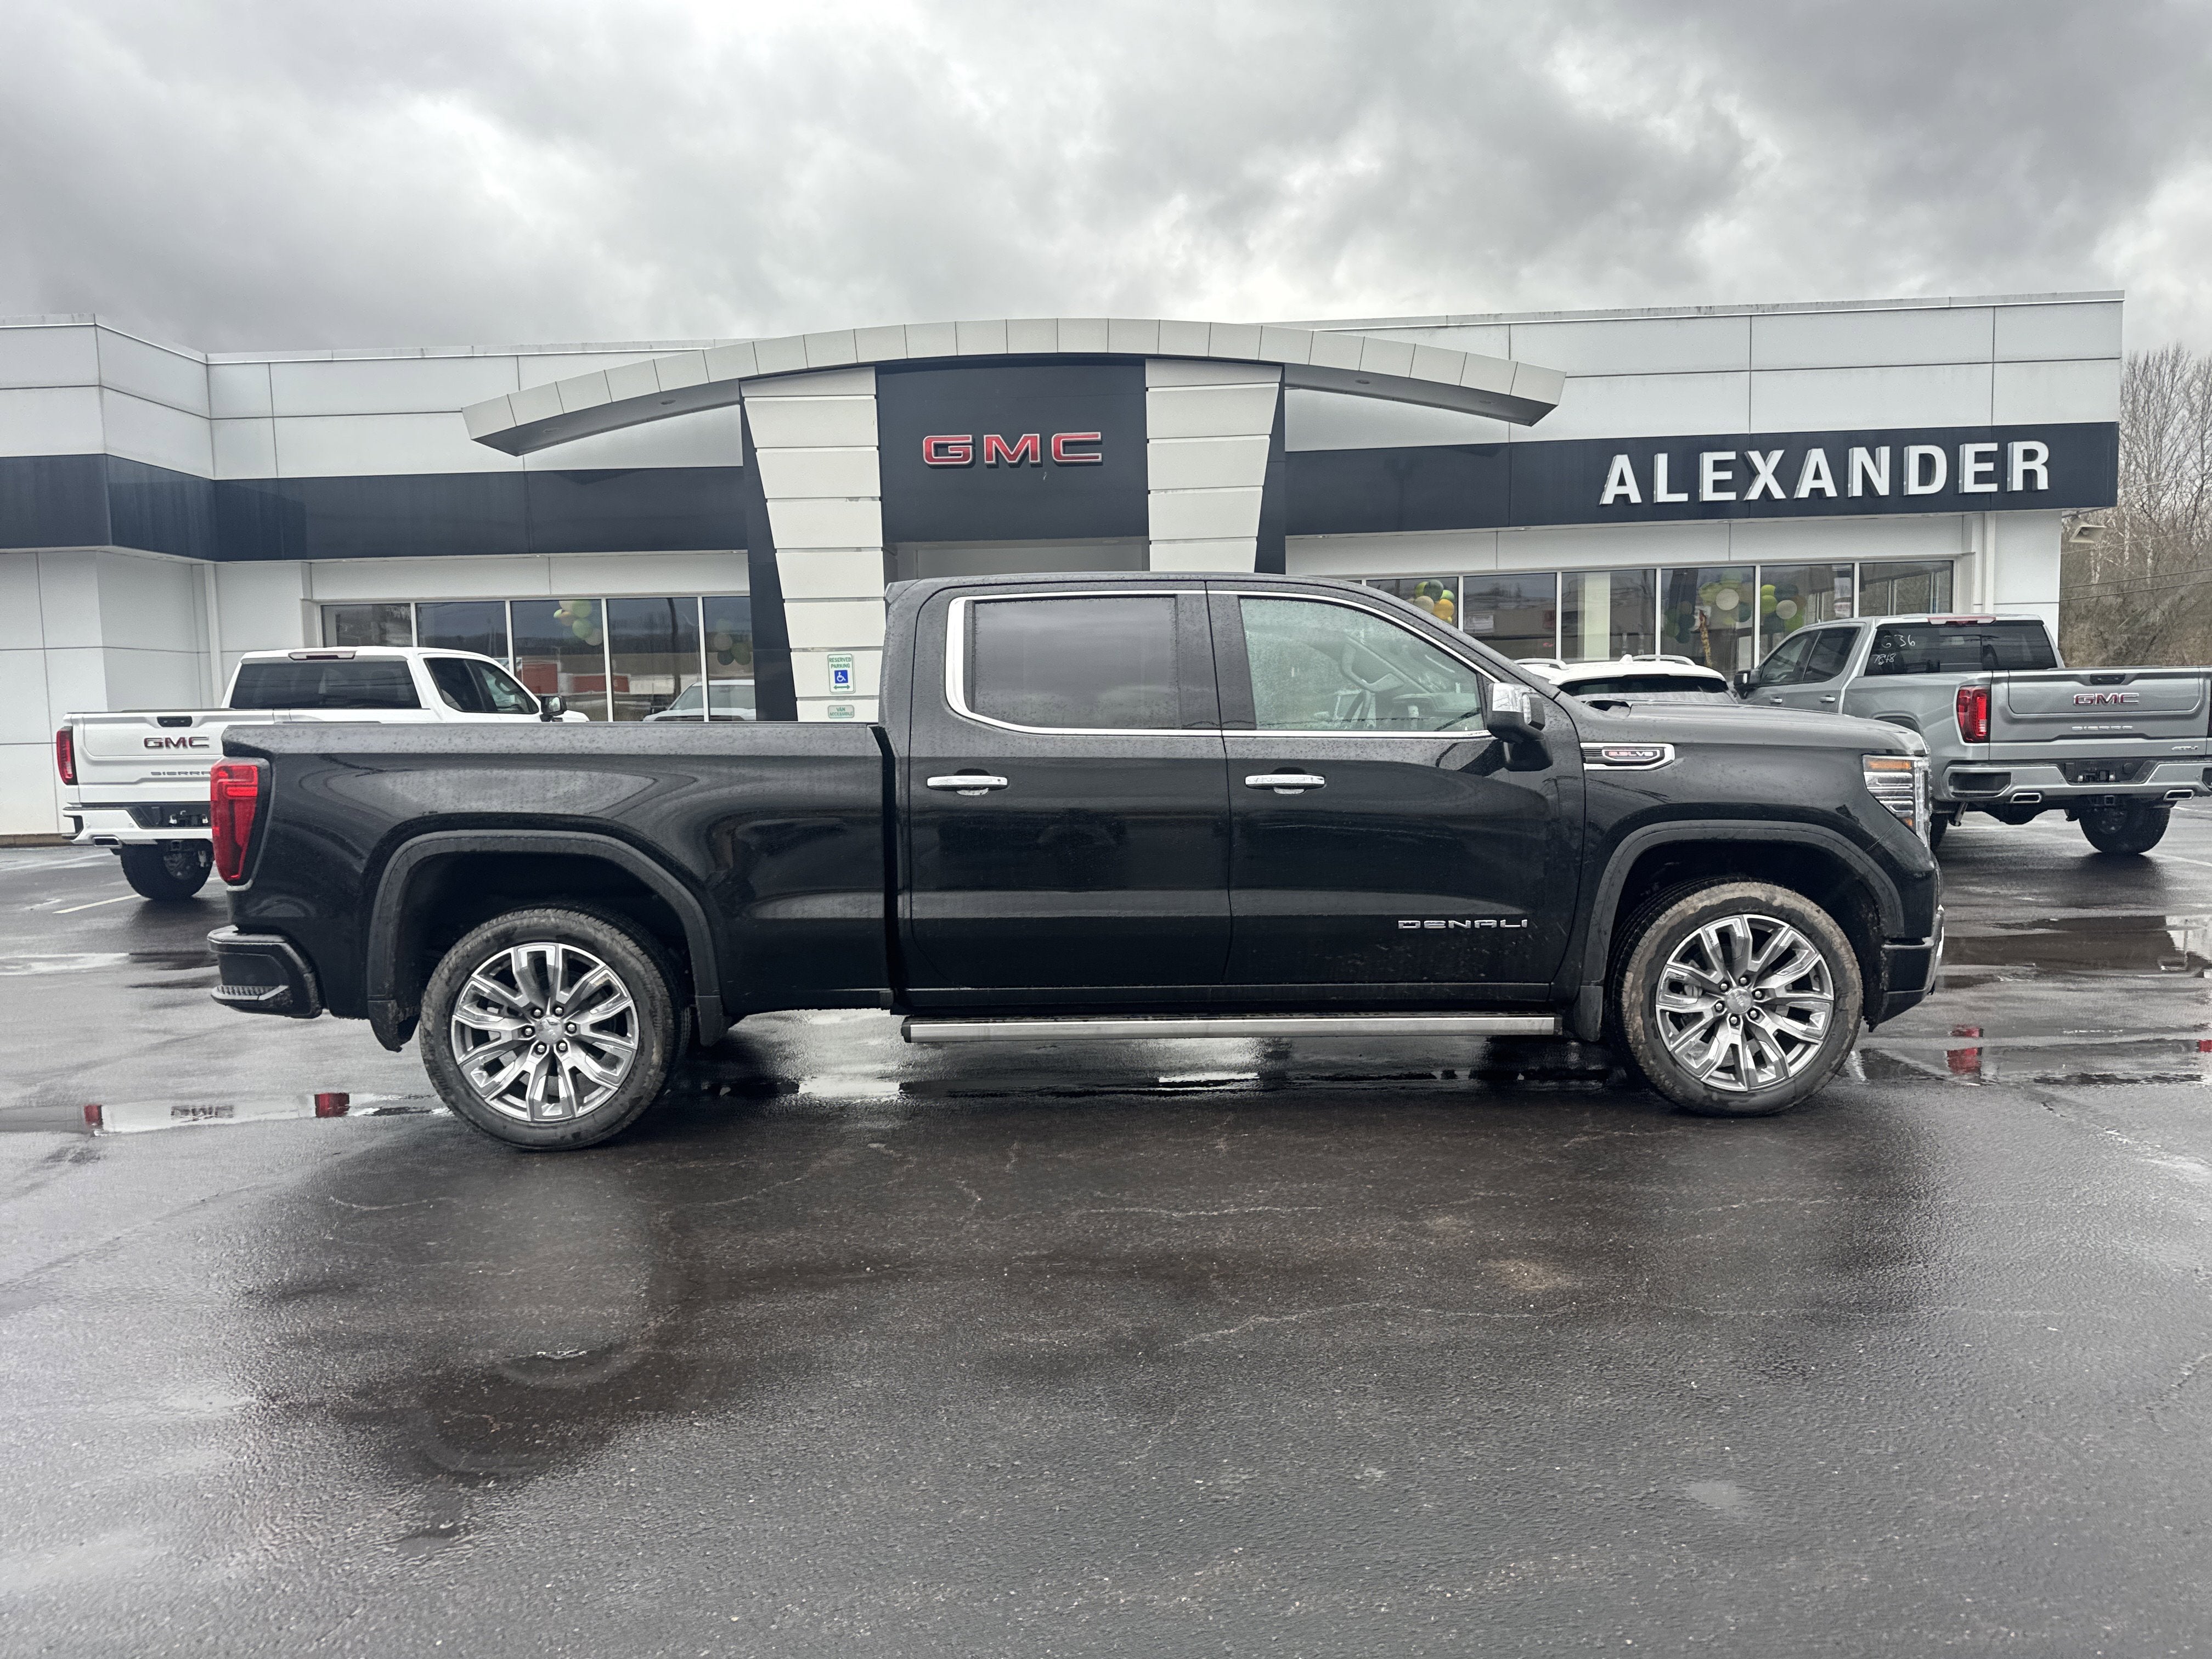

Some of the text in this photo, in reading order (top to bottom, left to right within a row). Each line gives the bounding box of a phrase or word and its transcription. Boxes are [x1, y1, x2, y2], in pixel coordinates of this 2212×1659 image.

[923, 432, 1102, 465] GMC
[1599, 441, 2049, 505] ALEXANDER
[2074, 692, 2139, 706] GMC
[144, 737, 209, 748] GMC
[1398, 919, 1527, 929] DENALI
